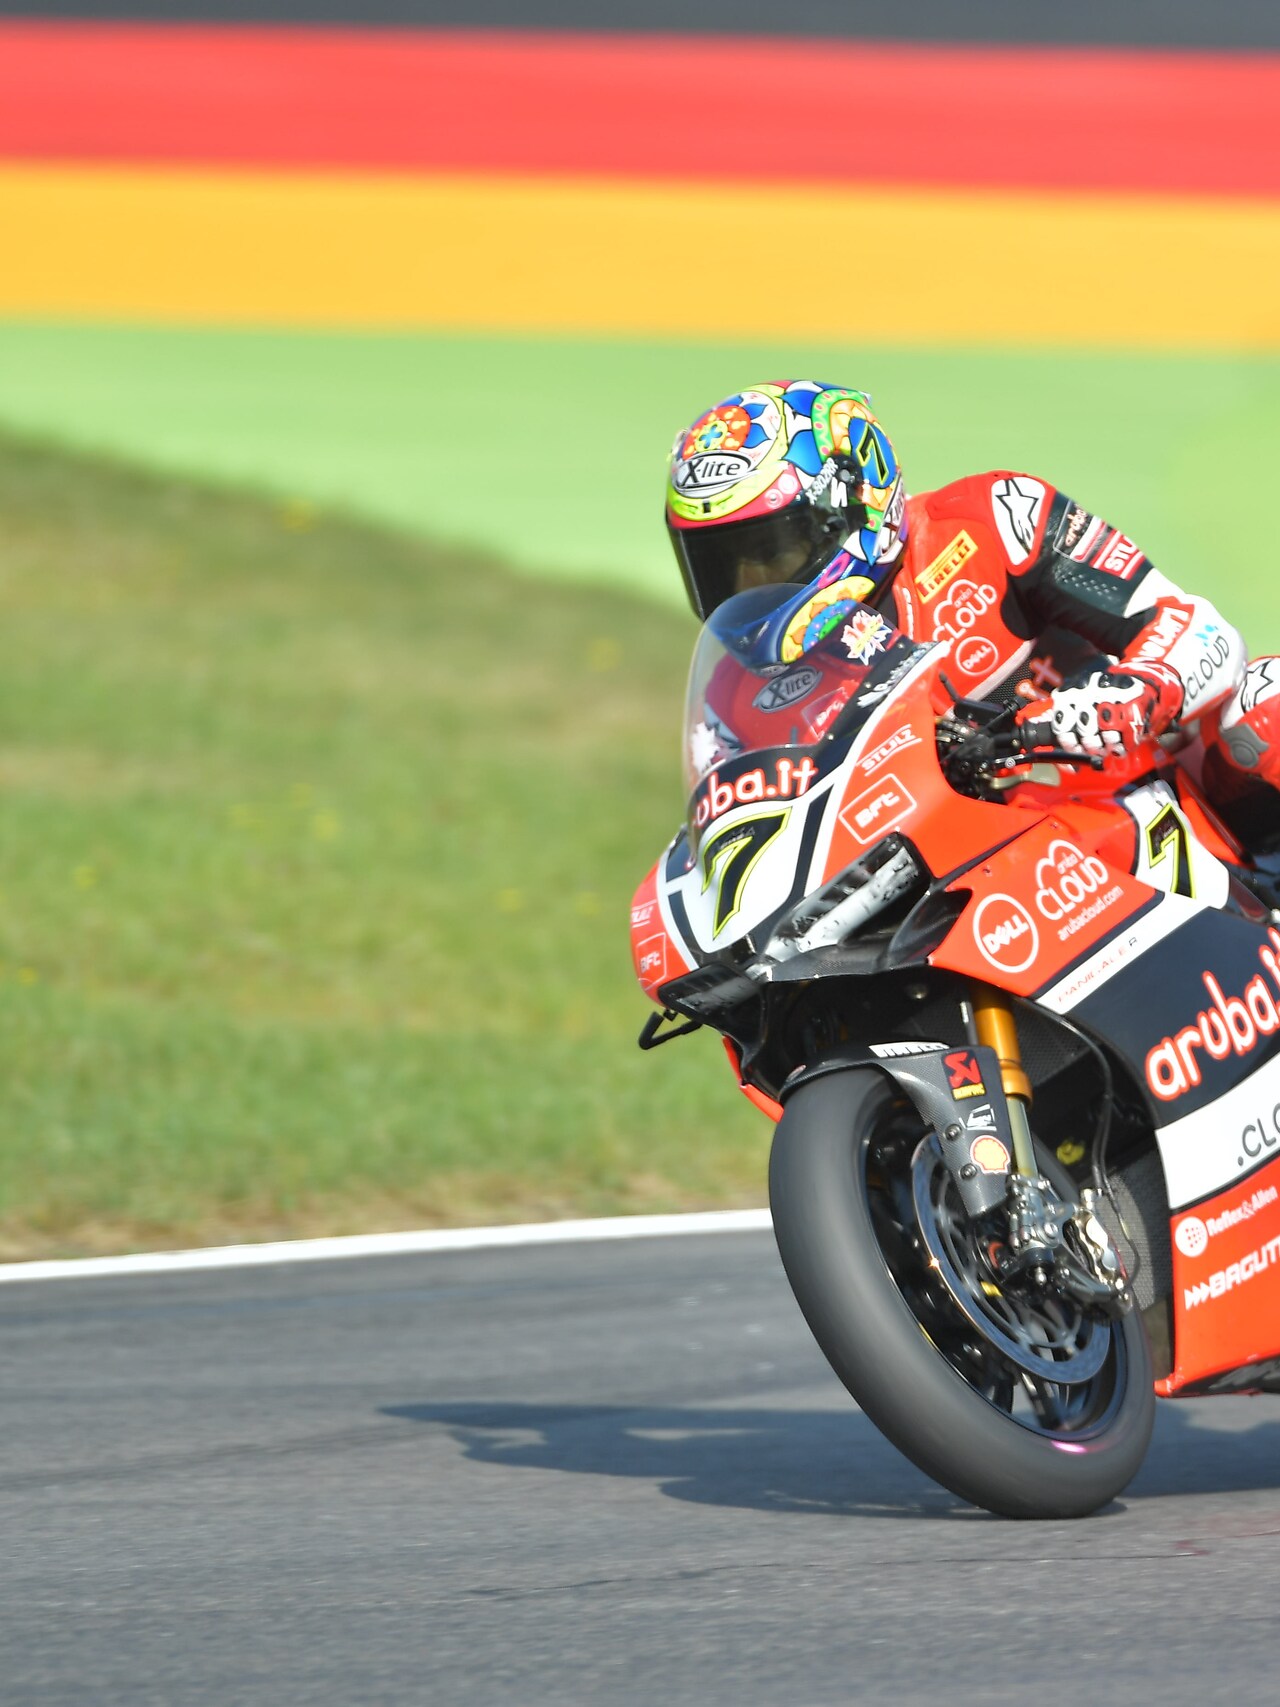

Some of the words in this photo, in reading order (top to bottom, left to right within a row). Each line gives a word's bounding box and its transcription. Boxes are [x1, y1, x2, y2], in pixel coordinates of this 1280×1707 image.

[681, 457, 742, 488] X-lite
[855, 420, 890, 486] 7
[915, 536, 972, 599] PIRELLI
[961, 644, 993, 671] DELL
[860, 729, 917, 771] STULZ
[693, 756, 820, 829] uba.it
[854, 791, 901, 829] Bft
[700, 805, 793, 942] 7
[1145, 802, 1197, 900] 7
[1035, 855, 1109, 921] CLOUD
[1057, 885, 1125, 942] arubacloud.com
[982, 914, 1030, 955] DELL
